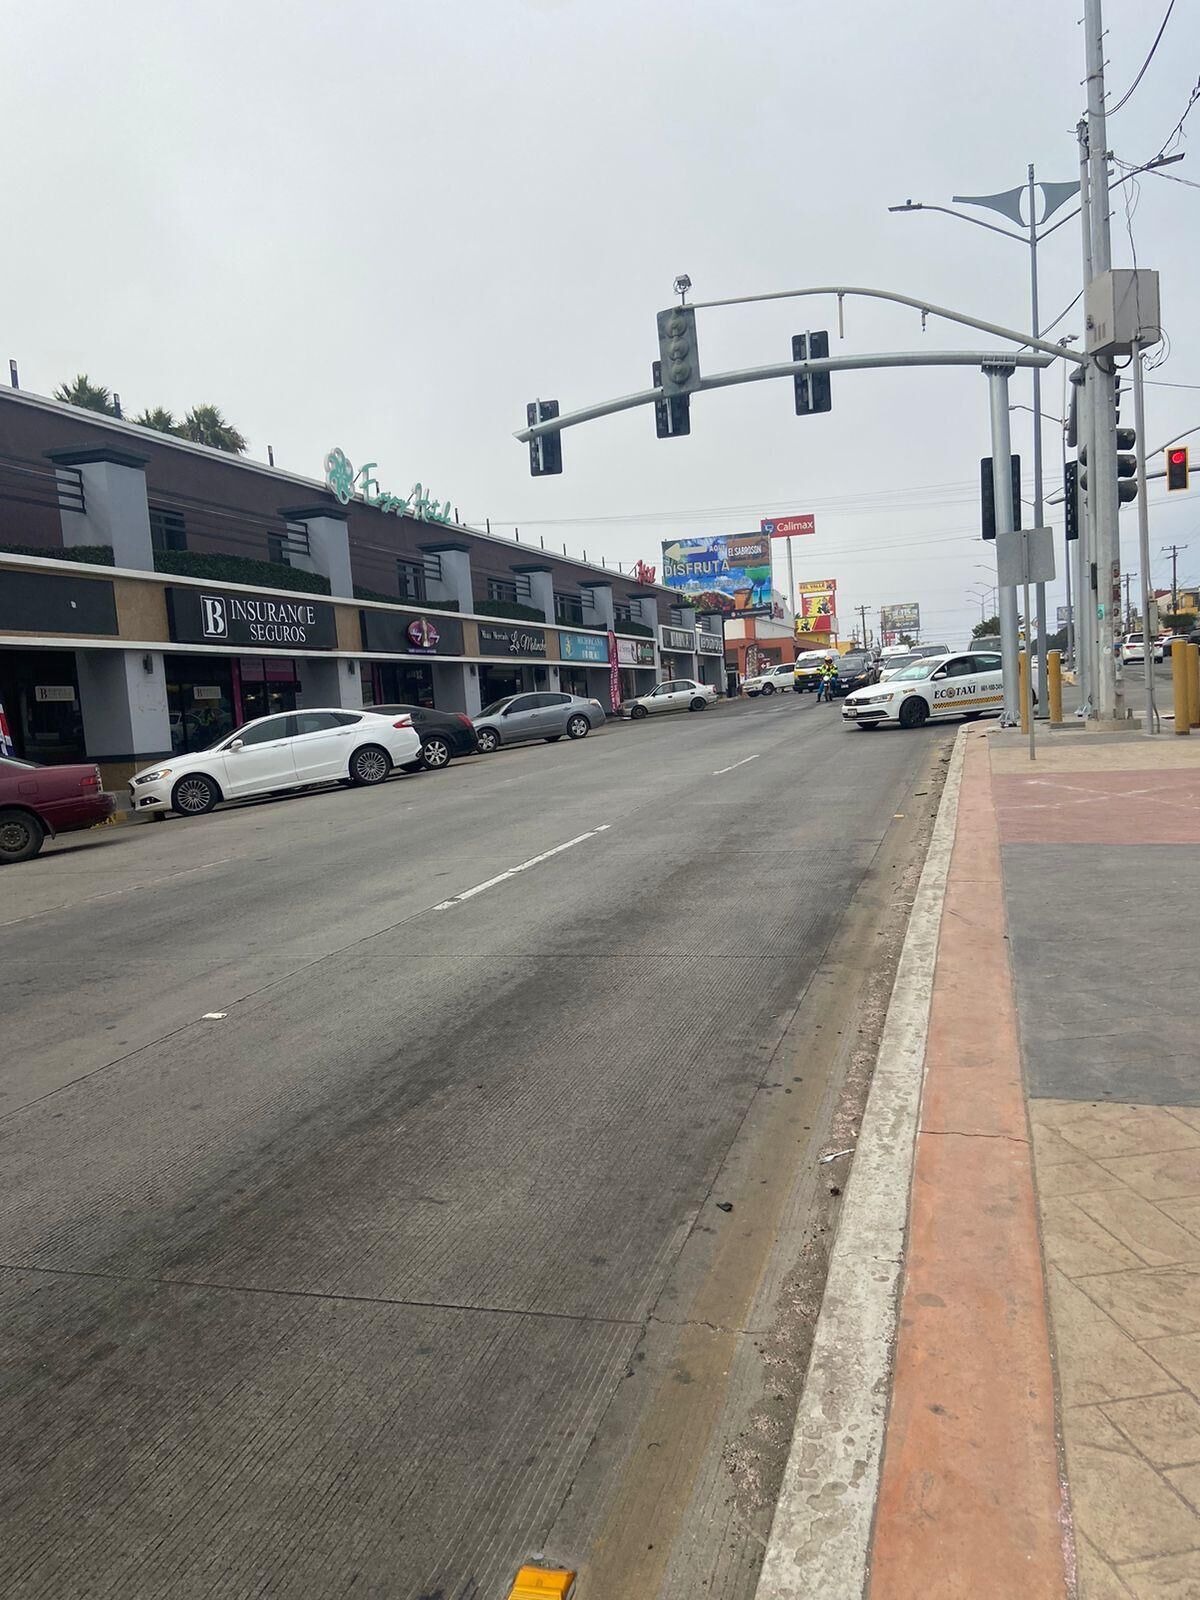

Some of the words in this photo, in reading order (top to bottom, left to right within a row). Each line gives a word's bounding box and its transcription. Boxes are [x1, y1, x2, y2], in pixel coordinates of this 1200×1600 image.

[776, 520, 814, 532] Calimax
[664, 559, 730, 577] DISFRUTA
[231, 599, 316, 625] INSURANCE
[250, 624, 306, 643] SEGUROS
